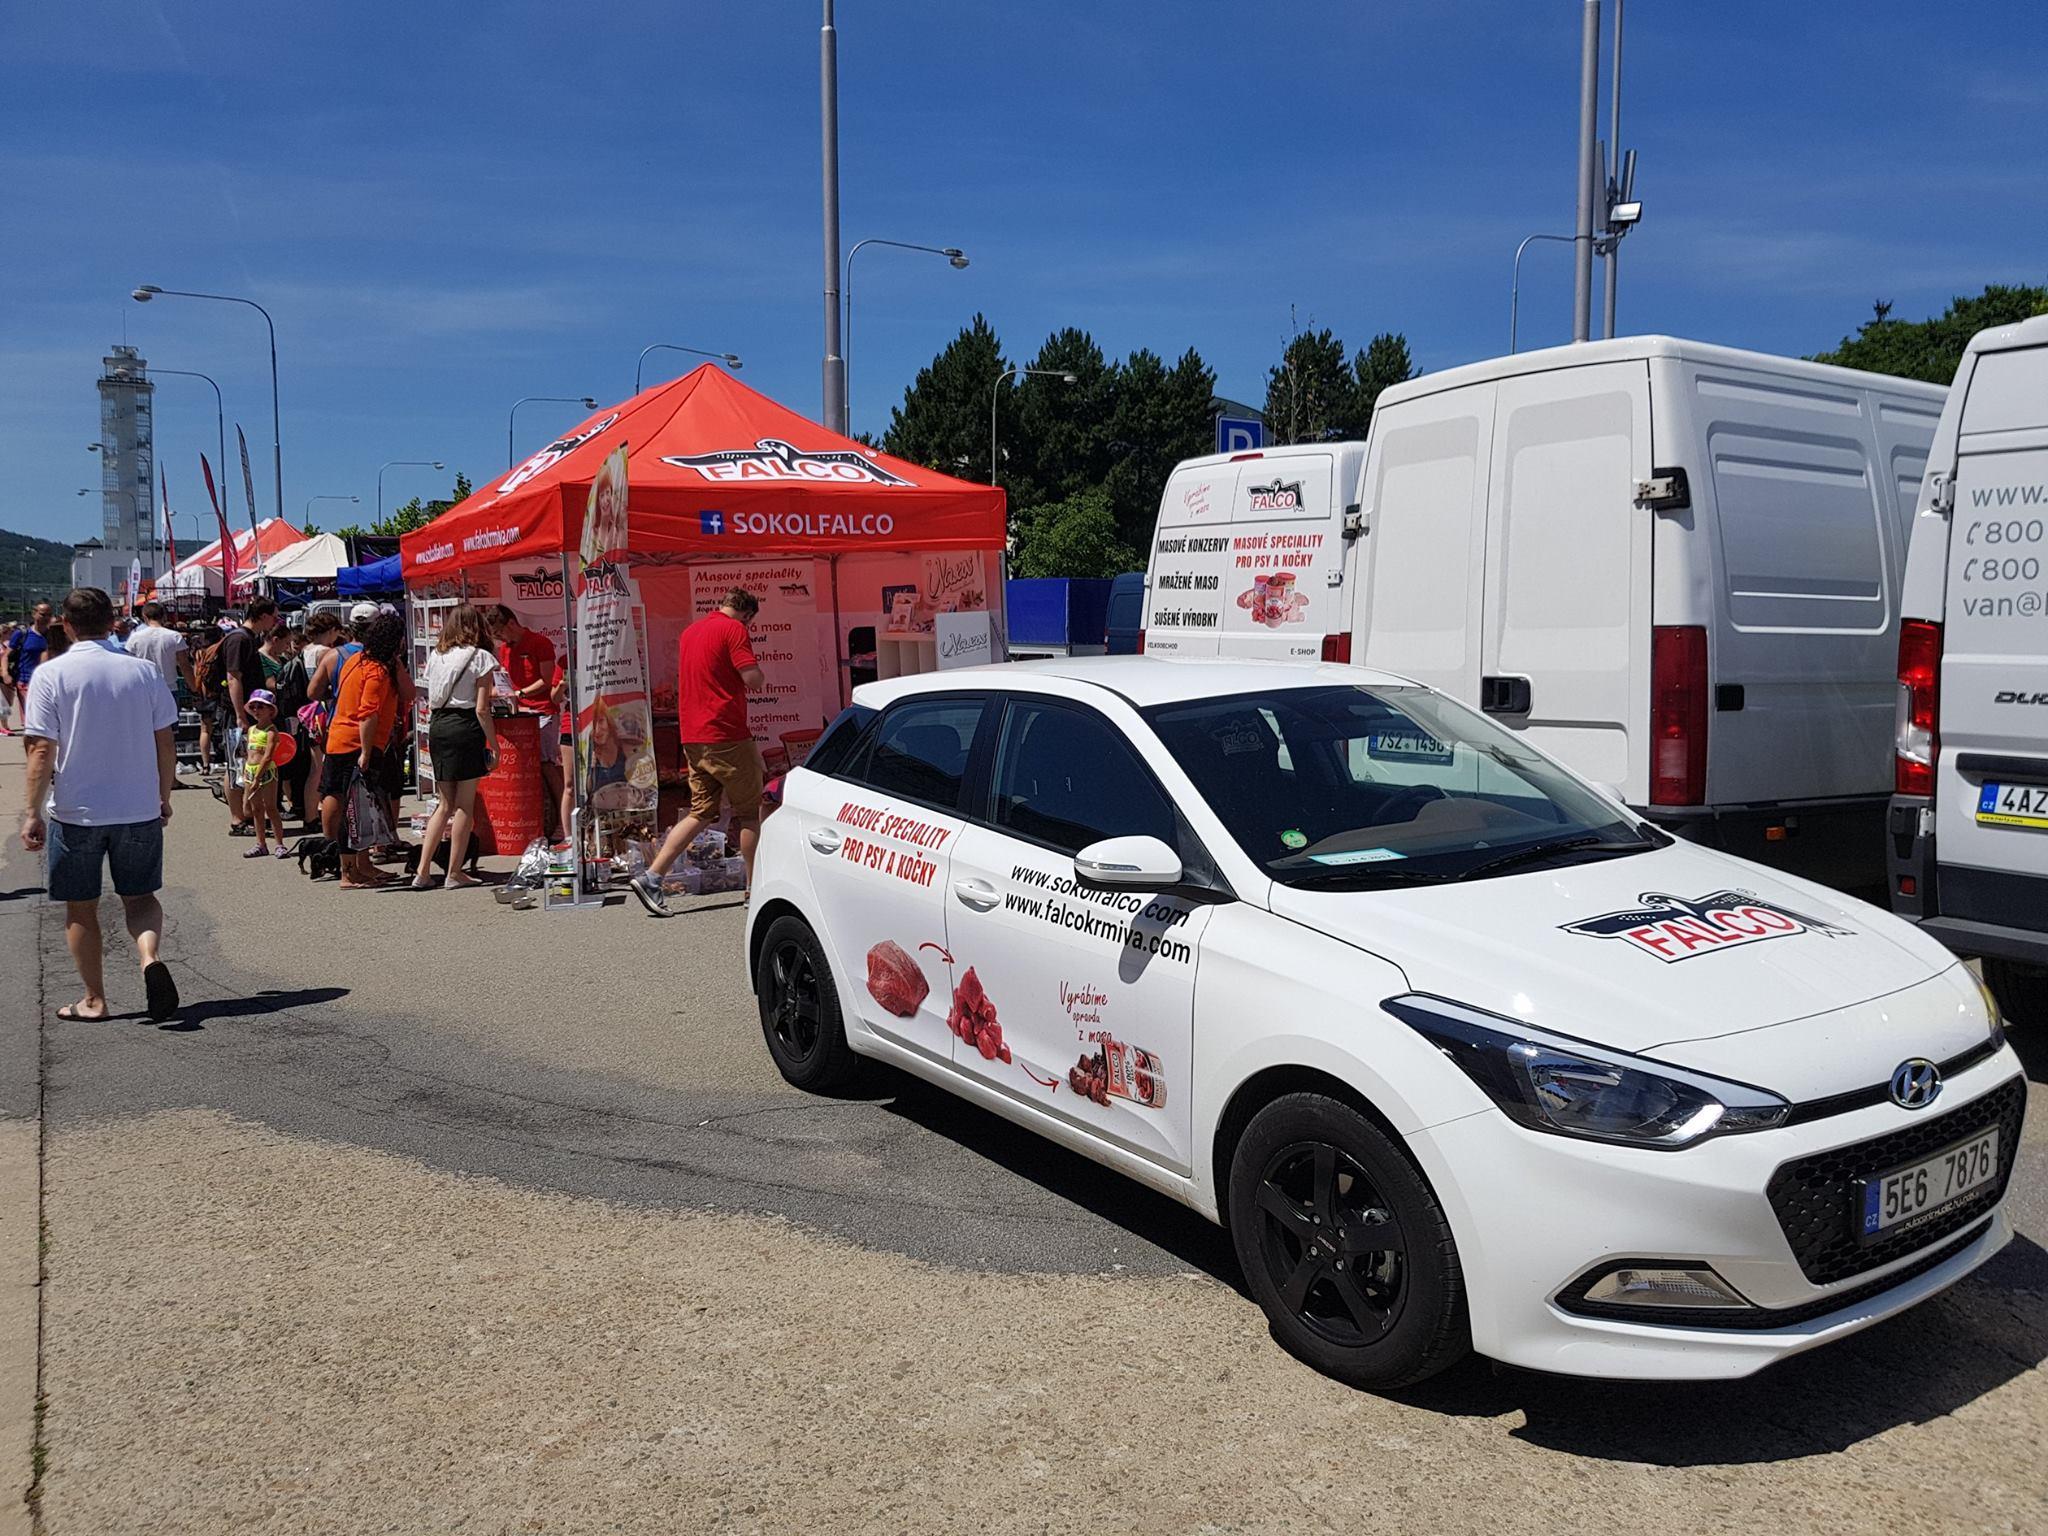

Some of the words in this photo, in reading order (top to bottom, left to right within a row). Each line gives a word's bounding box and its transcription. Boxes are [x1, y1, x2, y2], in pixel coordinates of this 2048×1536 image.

[706, 457, 866, 480] FALCO
[1253, 493, 1294, 508] FALCO
[733, 513, 893, 535] SOKOLFALCO
[1985, 520, 2043, 543] 800
[1158, 534, 1187, 553] MASOVÉ
[1188, 538, 1229, 552] KONZERVY
[1233, 533, 1268, 550] MASOVÉ
[1271, 535, 1323, 549] SPECIALITY
[1236, 556, 1252, 568] PRO
[1255, 555, 1271, 568] PSY
[1273, 555, 1279, 567] A
[1282, 550, 1313, 567] KOČKY
[695, 570, 742, 582] Masové
[745, 567, 802, 582] speciality
[1982, 557, 2039, 581] 800
[519, 582, 563, 597] FALCO
[1159, 571, 1193, 589] MRAŽENÉ
[1194, 575, 1219, 590] MASO
[761, 622, 792, 632] masa
[1154, 608, 1181, 626] SUŠENÉ
[1182, 608, 1218, 627] VÝROBKY
[1291, 648, 1316, 656] E-SHOP
[766, 683, 797, 693] firma
[1380, 732, 1402, 750] 7S2
[1982, 800, 1994, 810] CZ
[2001, 787, 2048, 814] 4AZ
[836, 803, 890, 833] MASOVÉ
[881, 814, 952, 851] SPECIALITY
[841, 837, 865, 864] PRO
[864, 844, 887, 871] PSY
[885, 851, 897, 876] A
[896, 851, 938, 888] KOČKY
[1004, 892, 1191, 965] www.falcokrmiva.com
[1626, 907, 1796, 957] FALCO
[1885, 1167, 1928, 1220] 5E6
[1944, 1139, 1991, 1198] 7876
[1865, 1212, 1878, 1227] CZ
